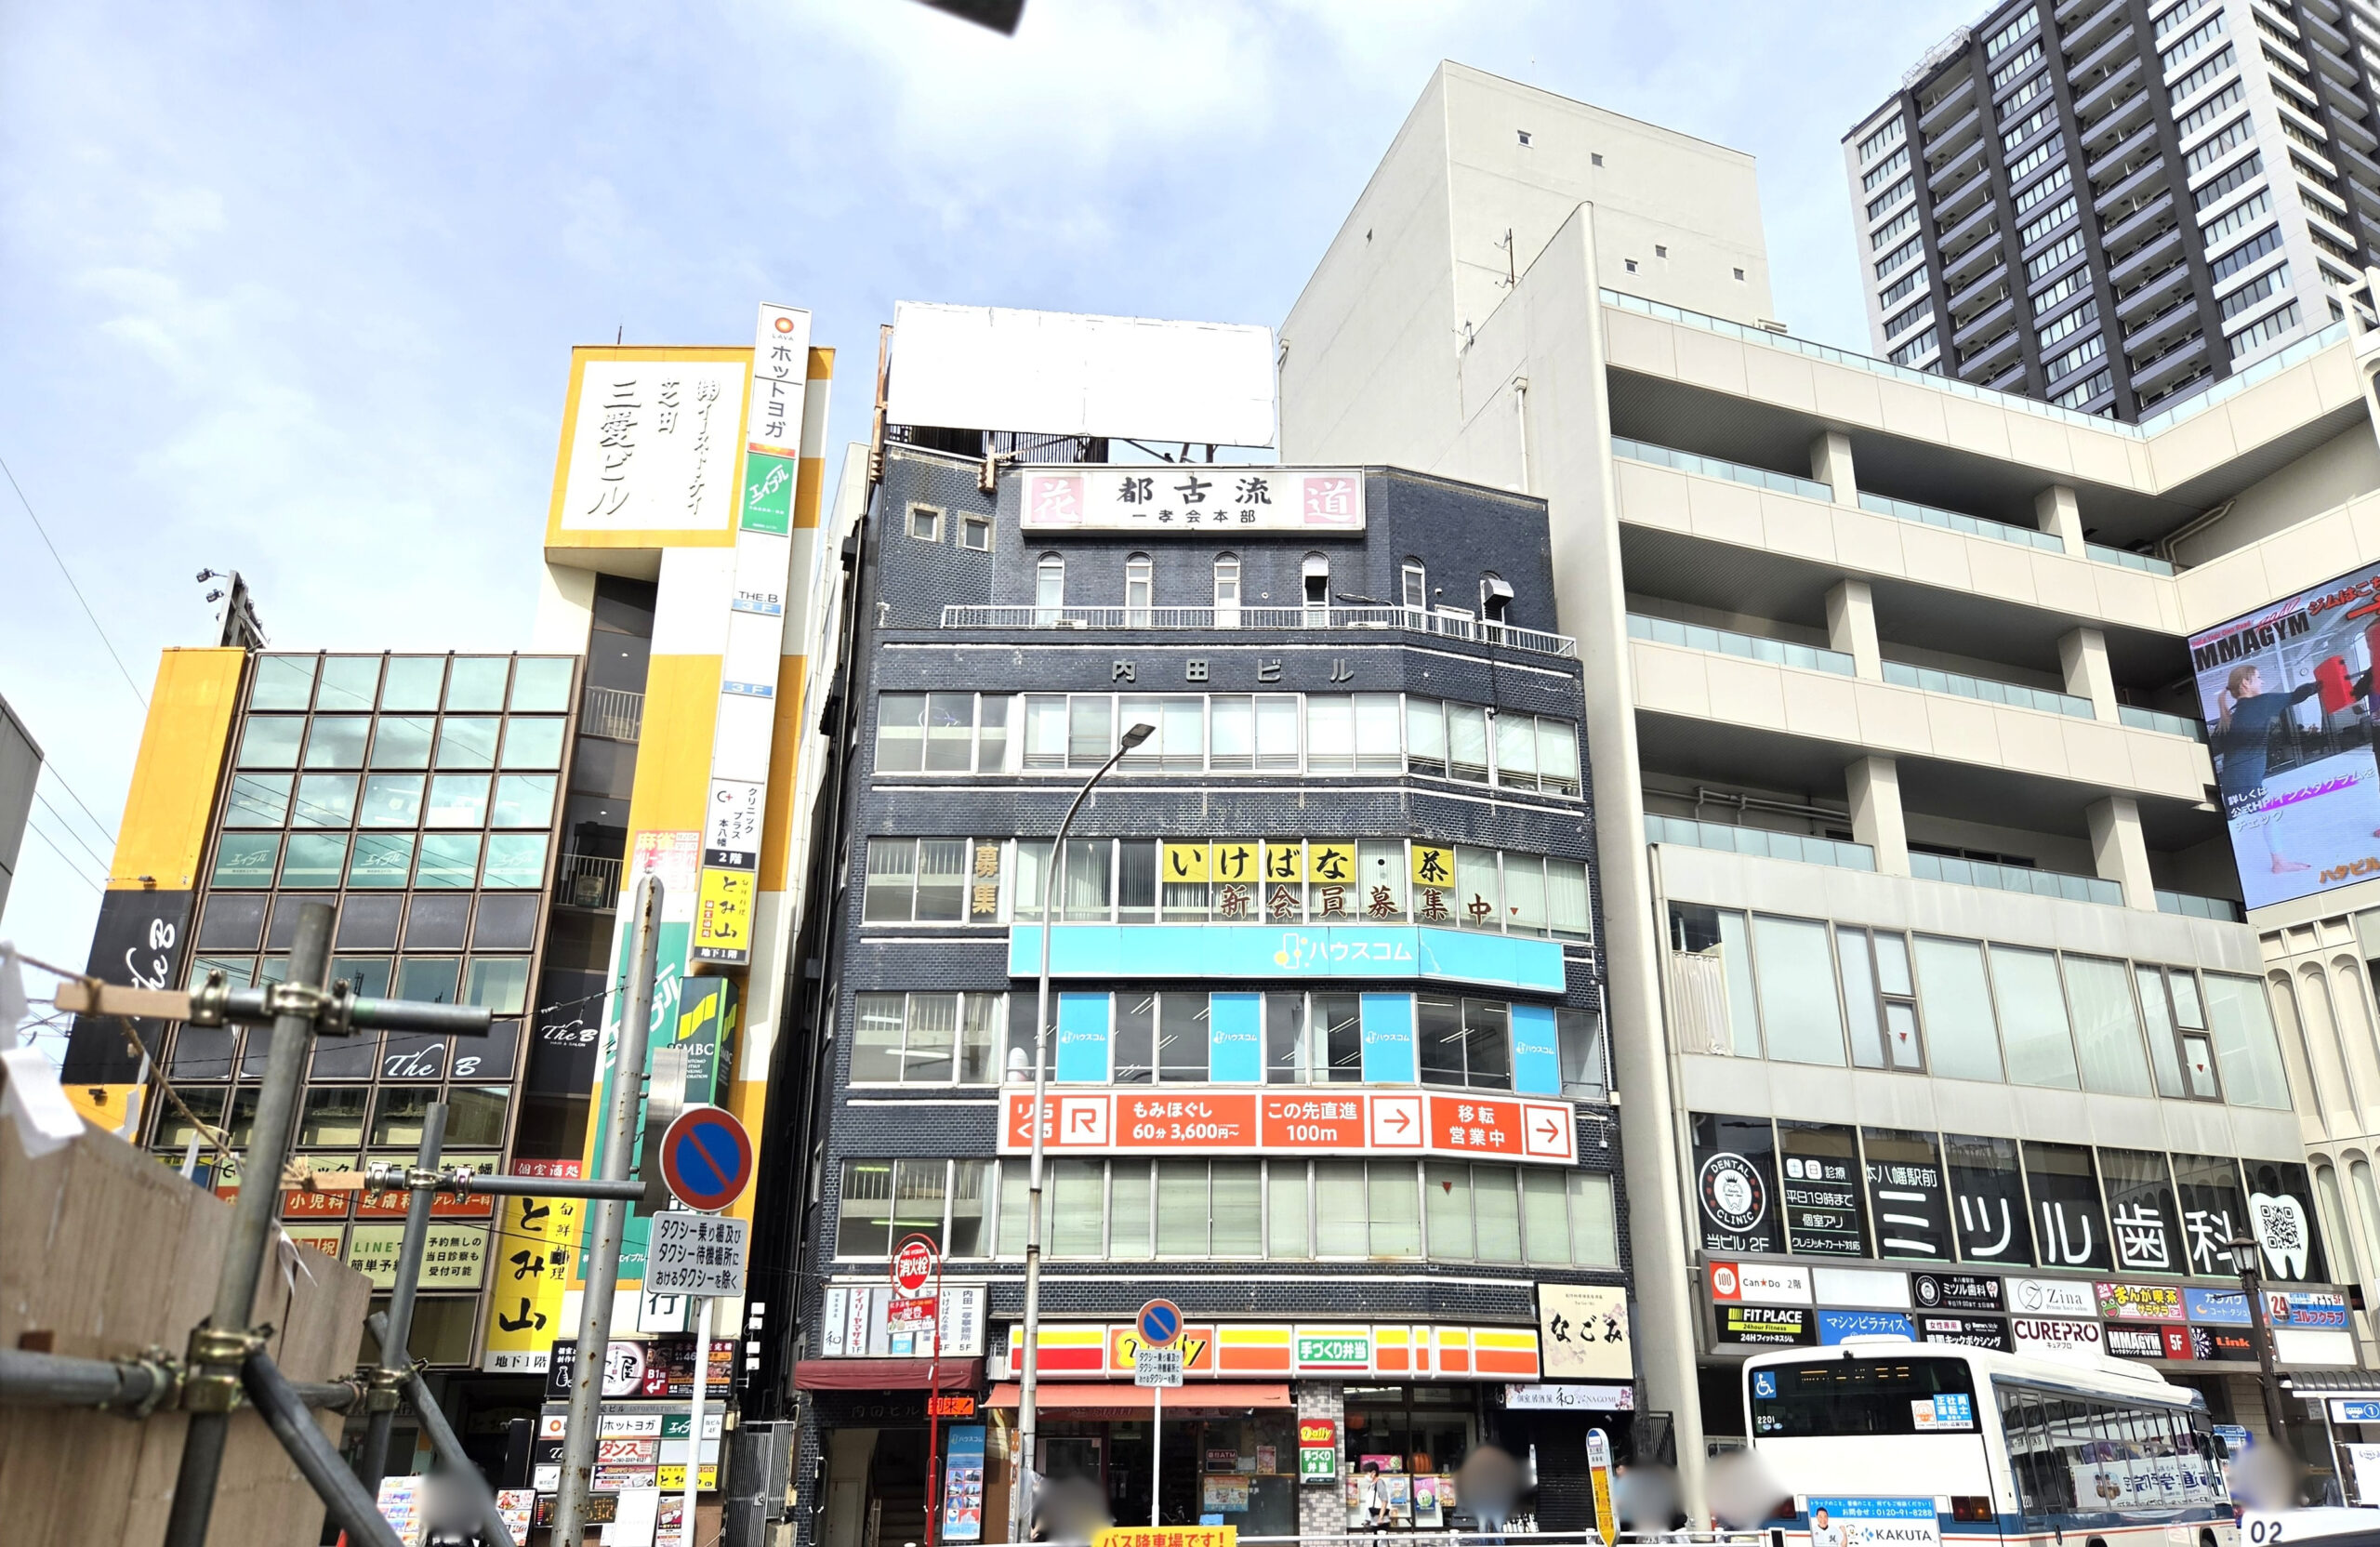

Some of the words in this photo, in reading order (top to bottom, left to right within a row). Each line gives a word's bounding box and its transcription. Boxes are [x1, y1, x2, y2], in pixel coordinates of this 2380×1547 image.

[765, 345, 792, 439] ホットヨガ
[588, 380, 641, 515] 三愛ビル
[749, 464, 789, 506] エイブル
[1033, 479, 1077, 522] 花
[1117, 476, 1272, 505] 都古流
[1307, 481, 1355, 521] 道
[1132, 509, 1256, 523] 一孝会本部
[1112, 658, 1355, 682] 内田ビル
[744, 787, 758, 834] クリニック
[2236, 810, 2284, 832] チェック
[717, 819, 729, 847] 本八幡
[226, 850, 271, 866] エイブル
[360, 850, 404, 866] エイブル
[719, 853, 743, 865] 2階
[715, 876, 737, 939] とみ山
[1220, 884, 1492, 927] 新会員募集中
[1310, 941, 1413, 962] ハウスコム
[1073, 1033, 1106, 1041] ハウスコム
[1223, 1033, 1257, 1041] ハウスコム
[1376, 1033, 1410, 1042] ハウスコム
[1525, 1044, 1555, 1056] ハウスコム
[385, 1043, 444, 1077] The
[455, 1056, 482, 1077] B
[1133, 1102, 1212, 1117] もみほぐし
[1268, 1102, 1357, 1119] この先直進
[1458, 1104, 1495, 1125] 移転
[1133, 1123, 1166, 1139] 60分
[1287, 1125, 1337, 1142] 100m
[1449, 1127, 1505, 1147] 営業中
[518, 1163, 579, 1178] 個室酒処
[1711, 1159, 1751, 1178] DENTAL
[1867, 1165, 1937, 1187] 本八幡駅前
[290, 1194, 344, 1210] 小児科
[1786, 1190, 1854, 1208] 平日19時まで
[1716, 1210, 1754, 1226] CLINIC
[1802, 1213, 1844, 1228] 個室アリ
[661, 1219, 741, 1244] タクシー乗り場及び
[1879, 1190, 2239, 1273] ミツル歯科
[429, 1237, 481, 1247] 予約無しの
[1707, 1234, 1745, 1251] 当ビル
[1750, 1236, 1769, 1252] 2F
[1792, 1237, 1860, 1250] クレジットカード対応
[426, 1251, 479, 1262] 当日診察も
[658, 1243, 739, 1266] タクシー待機場所に
[429, 1266, 472, 1276] 受付可能
[499, 1197, 550, 1332] とみ山
[900, 1256, 928, 1277] 消火栓
[655, 1268, 737, 1289] おけるタクシーを除く
[1787, 1279, 1802, 1290] 2階
[1943, 1283, 1986, 1297] ミツル歯科
[2046, 1289, 2082, 1305] Zina
[2114, 1285, 2179, 1304] まんが喫茶
[2271, 1295, 2289, 1315] 24
[1744, 1309, 1765, 1322] FIT
[1765, 1310, 1802, 1324] PLACE
[1827, 1316, 1906, 1332] マシンピラティス
[1551, 1313, 1623, 1343] なごみ
[2015, 1320, 2099, 1342] CUREPRO
[1740, 1333, 1794, 1343] 24Hフィットネスジム
[2108, 1331, 2162, 1350] MMAGYM
[2169, 1334, 2183, 1351] 5F
[2215, 1336, 2250, 1347] Link
[1301, 1341, 1367, 1359] 手づくり弁当
[495, 1355, 548, 1368] 地下1階
[603, 1420, 655, 1432] ホットヨガ
[1301, 1426, 1332, 1441] Daily
[600, 1440, 638, 1457] ダンス
[1304, 1450, 1330, 1461] 手づくり
[1307, 1462, 1328, 1473] 弁当
[1876, 1529, 1932, 1541] KAKUTA
[2251, 1521, 2282, 1544] 02
